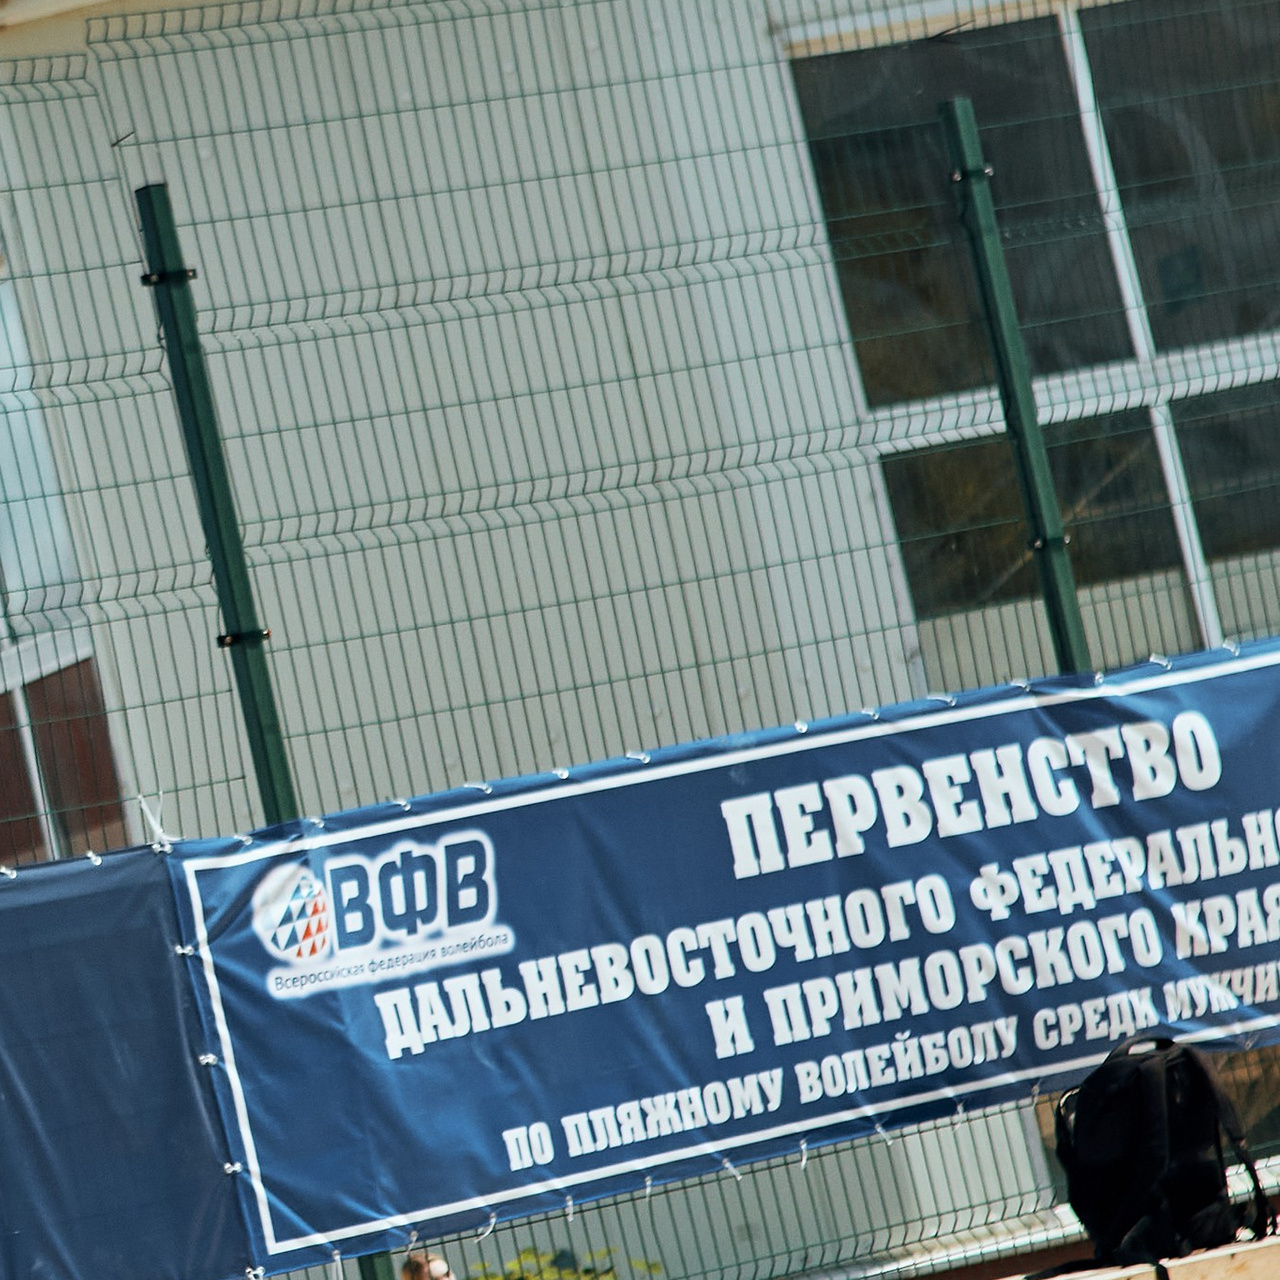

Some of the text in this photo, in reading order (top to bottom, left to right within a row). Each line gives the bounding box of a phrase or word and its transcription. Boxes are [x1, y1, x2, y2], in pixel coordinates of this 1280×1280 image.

[720, 710, 1223, 880] ПЕРВЕНСТВО
[328, 838, 492, 953] ВФВ
[368, 946, 438, 974] федерация
[440, 932, 509, 958] волейбола
[374, 808, 1280, 1060] ДАЛЬНЕВОСТОЧНОГО ФЕДЕРАЛЬН
[705, 995, 755, 1060] И
[763, 908, 1163, 1047] ПРИМОРСКОГО
[502, 1121, 554, 1172] ПО
[561, 1068, 783, 1159] ПЛЯЖНОМУ
[794, 1015, 1019, 1105] ВОЛЕЙБОЛУ
[1162, 960, 1280, 1024] МУЖЧИ
